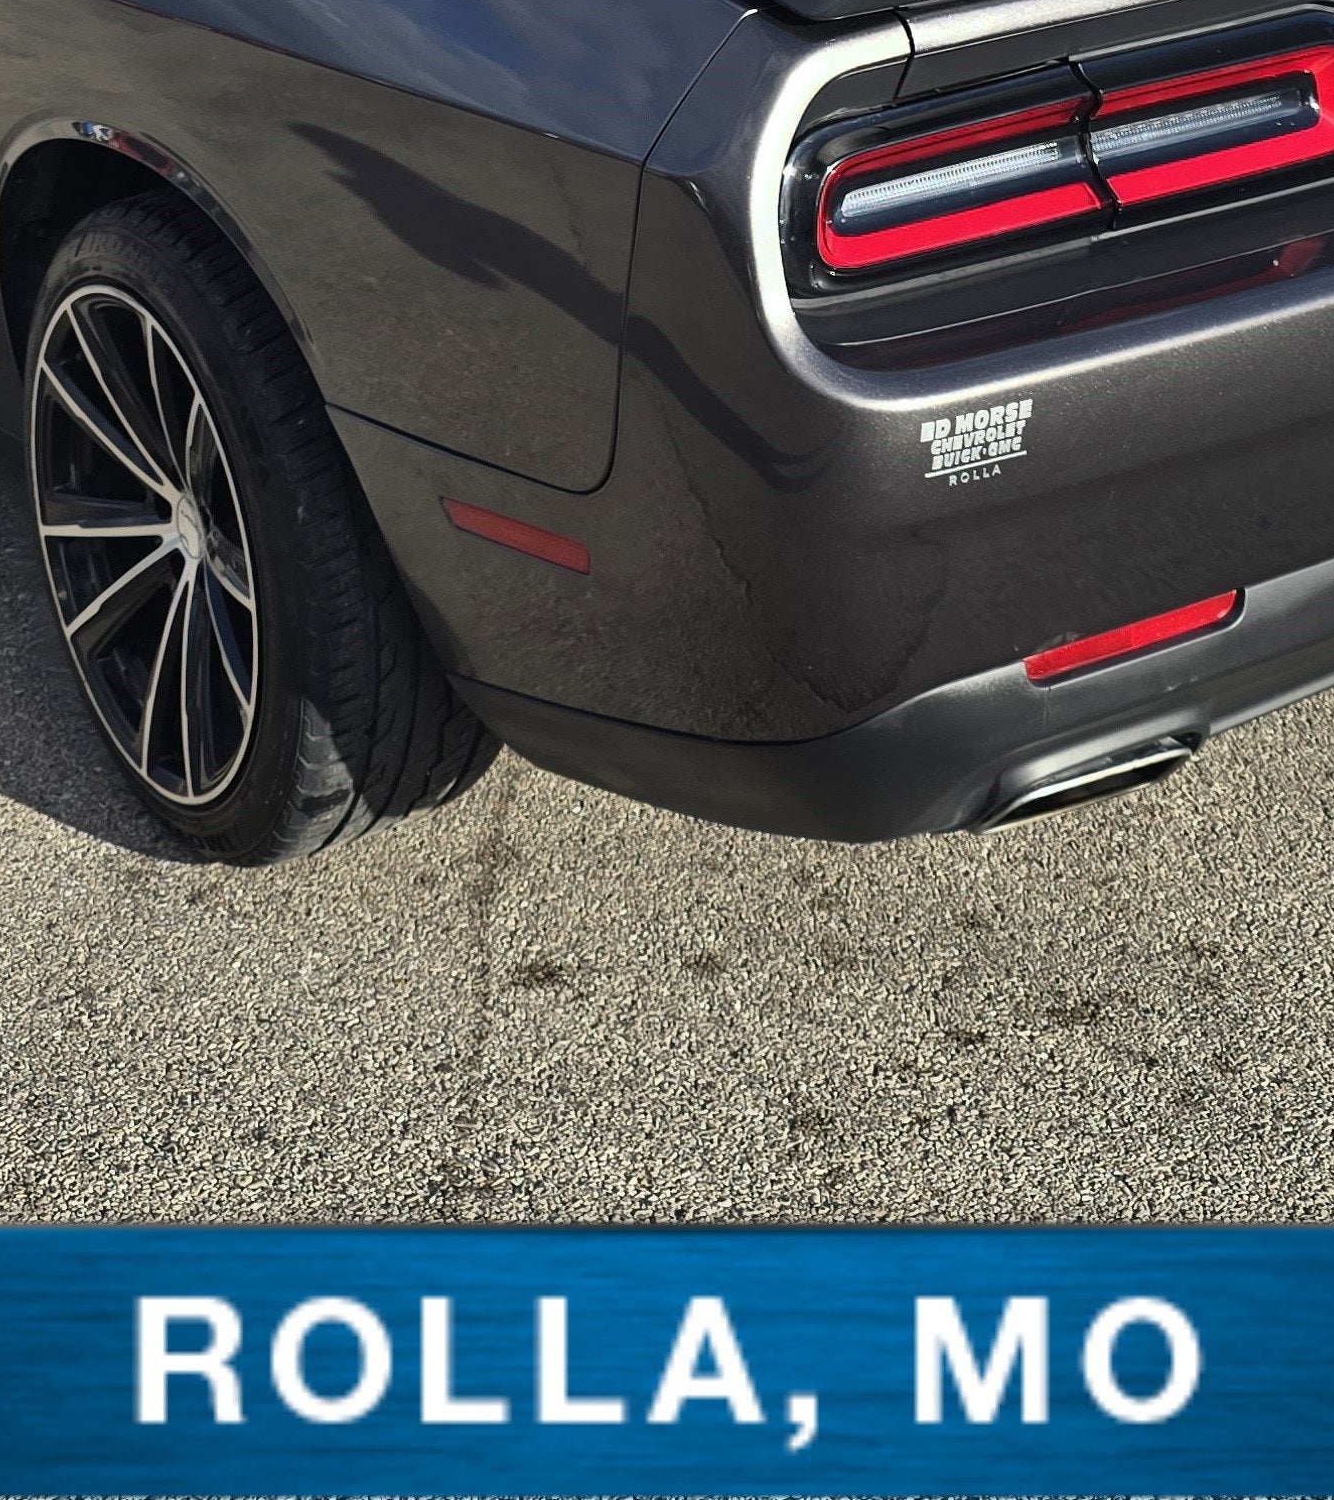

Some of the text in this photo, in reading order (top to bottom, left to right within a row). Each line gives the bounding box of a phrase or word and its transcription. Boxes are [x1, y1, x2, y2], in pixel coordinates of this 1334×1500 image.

[920, 399, 1033, 443] ED MORSE
[930, 420, 1026, 455] CHEVROLET
[949, 464, 1001, 487] ROLLA
